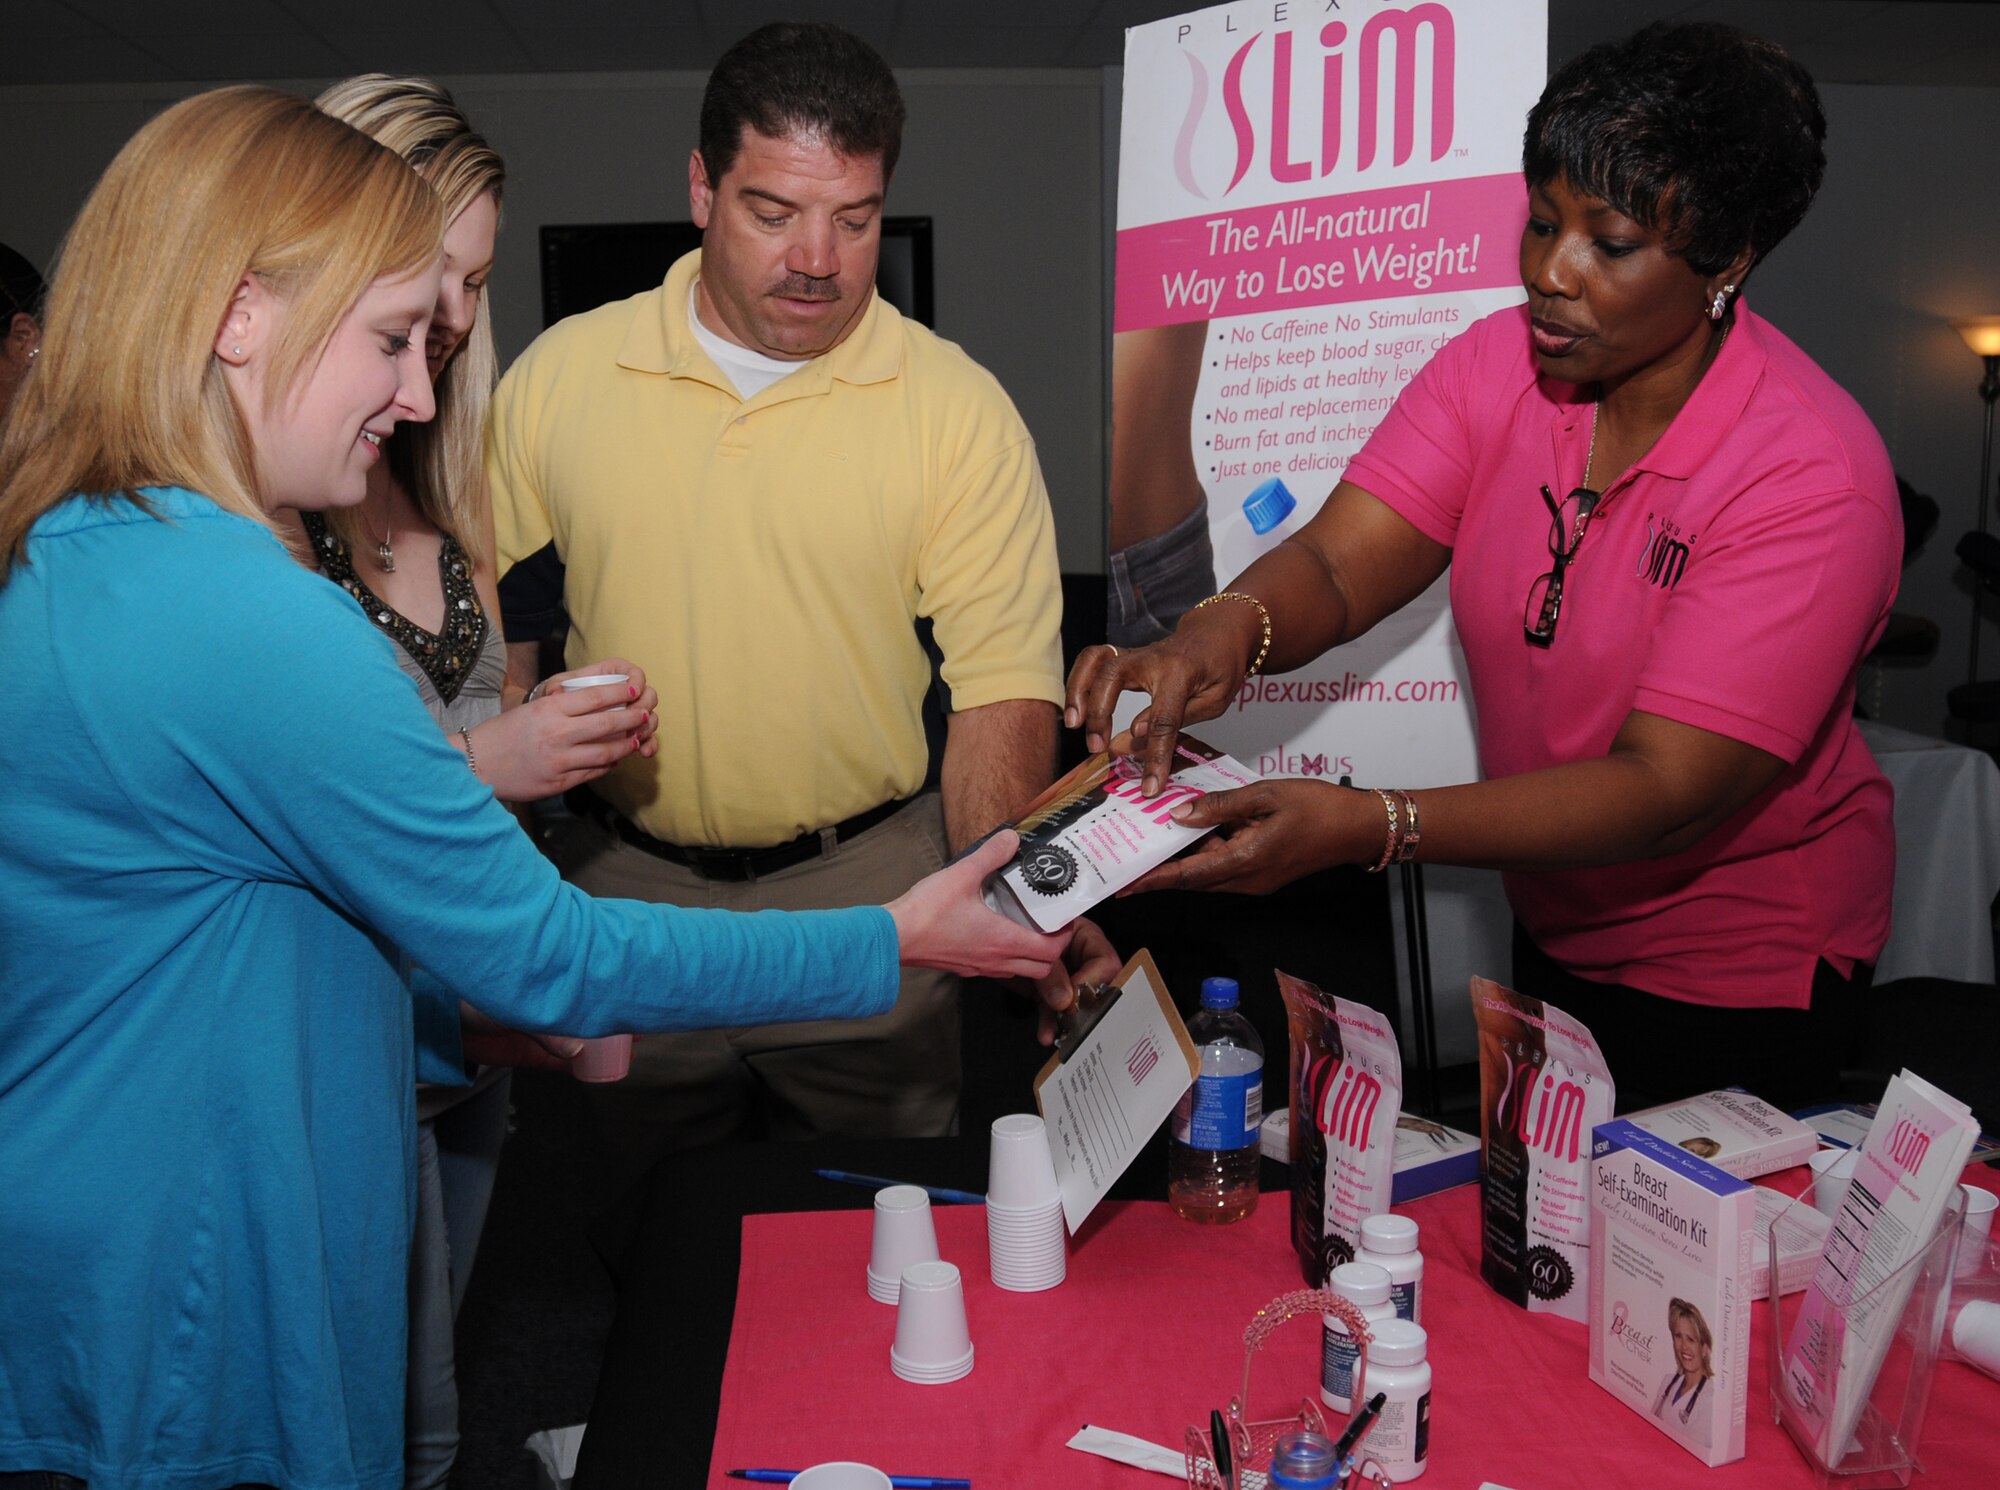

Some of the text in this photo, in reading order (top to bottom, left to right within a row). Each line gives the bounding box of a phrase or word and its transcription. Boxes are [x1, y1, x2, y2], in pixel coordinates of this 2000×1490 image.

[1178, 0, 1391, 43] PLEX
[1206, 190, 1431, 256] The All-natural
[1162, 233, 1481, 314] Way to Lose Weight!
[1231, 307, 1459, 344] No Caffeine No Stimulants
[1224, 352, 1270, 373] Helps
[1277, 348, 1315, 368] keep
[1322, 340, 1368, 361] blood
[1374, 338, 1425, 359] sugar,
[1220, 363, 1418, 398] and lipids at healthy lev
[1214, 395, 1396, 424] No meal replacement
[1214, 423, 1375, 452] Burn fat and inches
[1216, 453, 1350, 483] Just one deliciou
[1026, 863, 1046, 883] DAY
[1035, 854, 1065, 881] 60
[1594, 1140, 1610, 1154] NEW!
[1551, 1188, 1585, 1202] Stimulants
[1552, 1174, 1579, 1187] Caffeine
[1633, 1162, 1668, 1200] Breast
[1540, 1207, 1583, 1224] Replacements
[1550, 1201, 1566, 1211] Meal
[1598, 1165, 1687, 1236] Self-Examination
[1690, 1218, 1708, 1248] Kit
[1548, 1221, 1570, 1235] Shakes
[1622, 1210, 1657, 1237] Detection
[1658, 1231, 1680, 1249] Saves
[1680, 1245, 1703, 1264] Lives
[1532, 1259, 1559, 1285] 60
[1532, 1278, 1553, 1294] DAY
[1611, 1312, 1654, 1350] Breast
